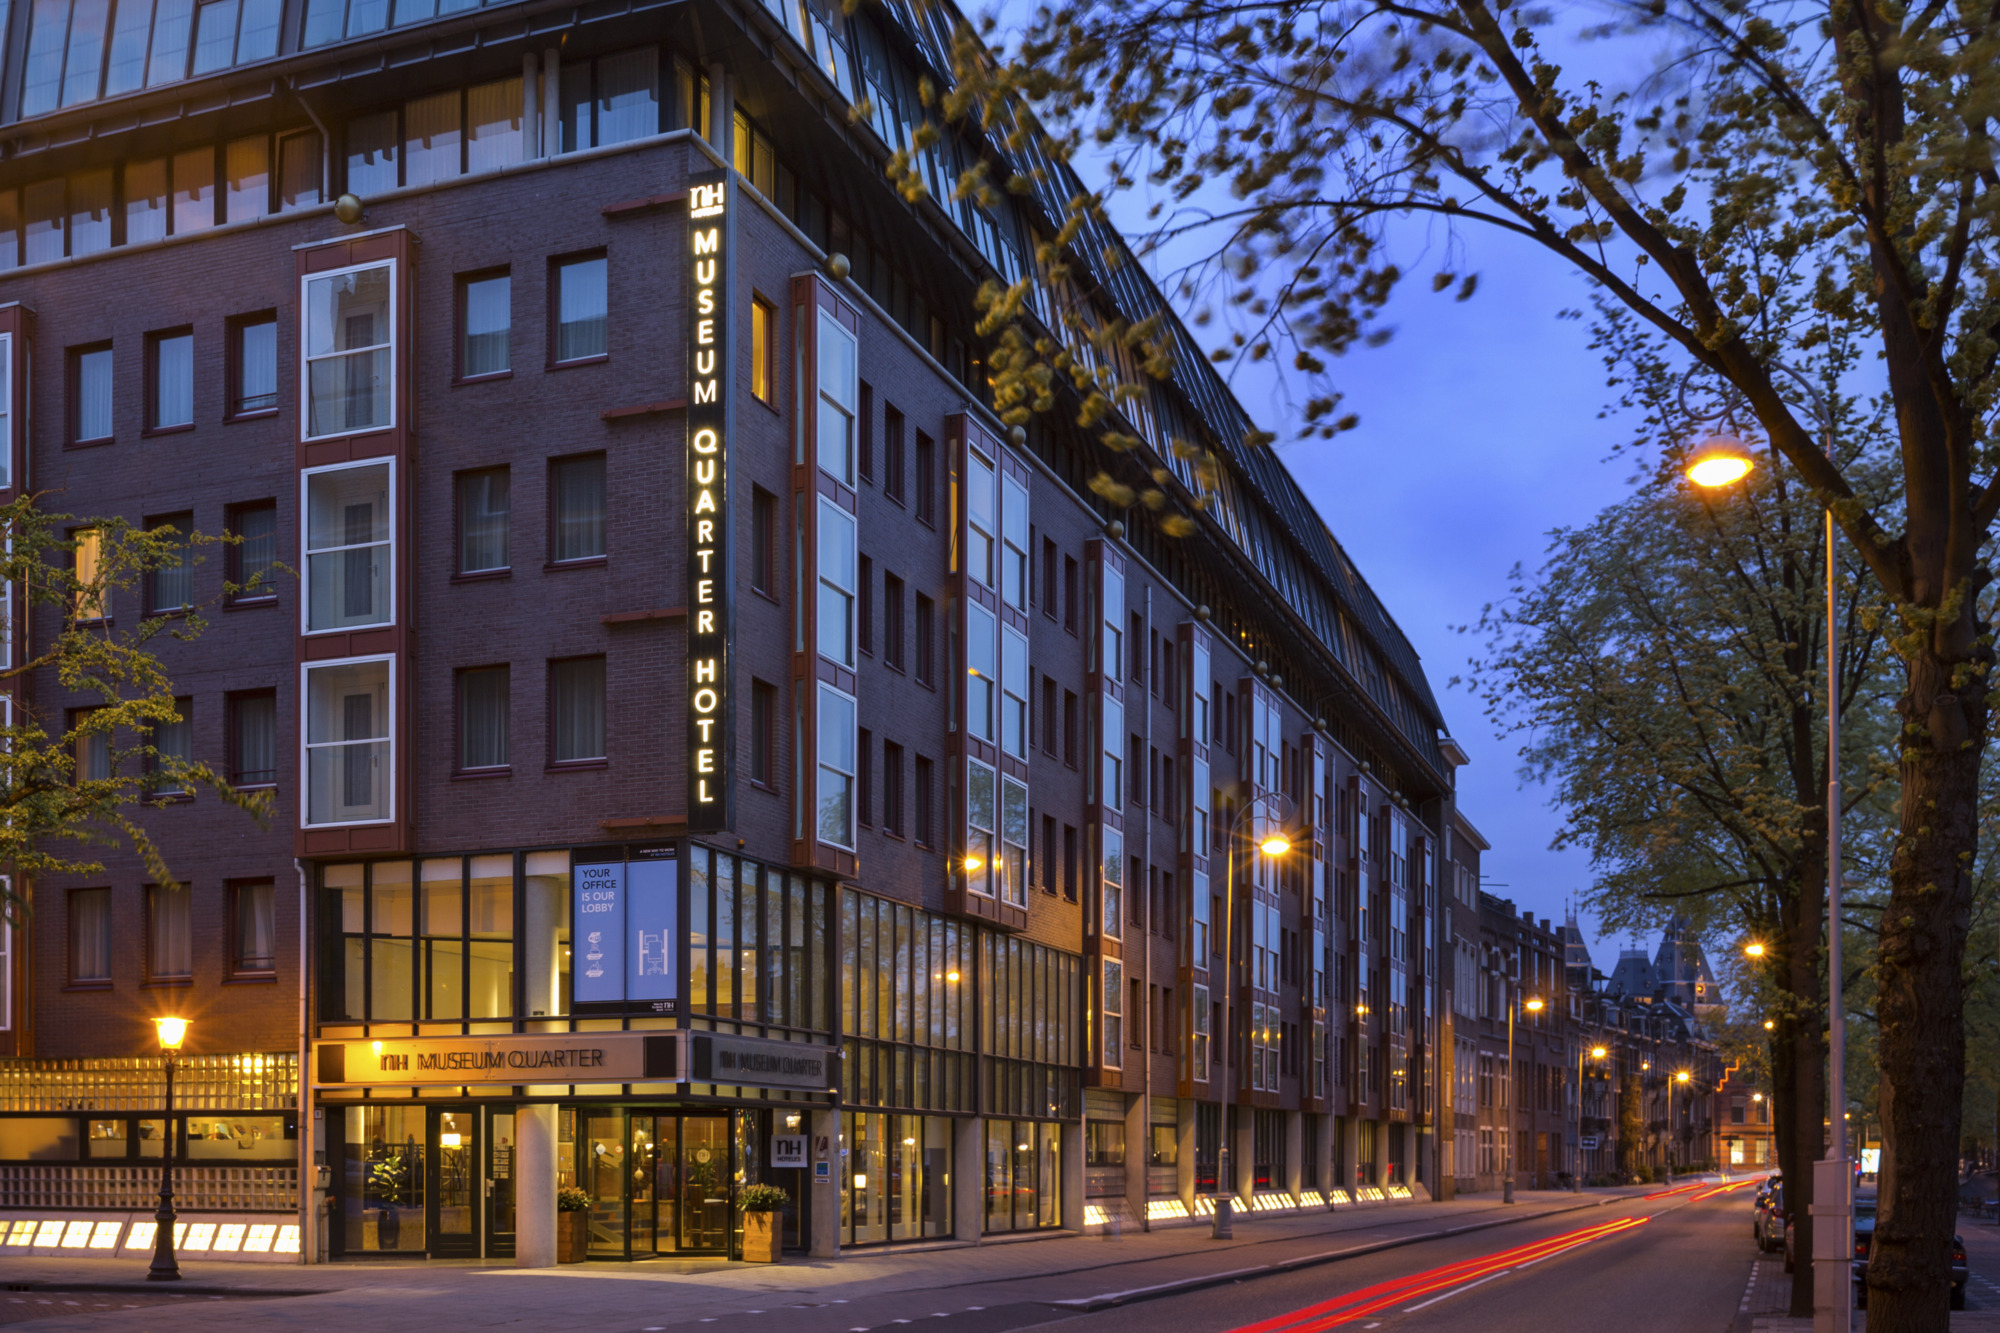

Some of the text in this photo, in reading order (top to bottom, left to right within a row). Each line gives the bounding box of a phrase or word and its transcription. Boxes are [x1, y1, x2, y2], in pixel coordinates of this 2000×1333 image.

[694, 228, 718, 803] MUSEUM QUARTER HOTEL
[582, 869, 610, 878] YOUR
[582, 880, 616, 890] OFFICE
[581, 891, 615, 902] IS OUR
[581, 903, 614, 913] LOBBY
[418, 1051, 501, 1070] MUSEUM
[508, 1049, 603, 1068] QUARTER
[738, 1052, 780, 1073] MUSEUM
[782, 1057, 822, 1076] QUARTER
